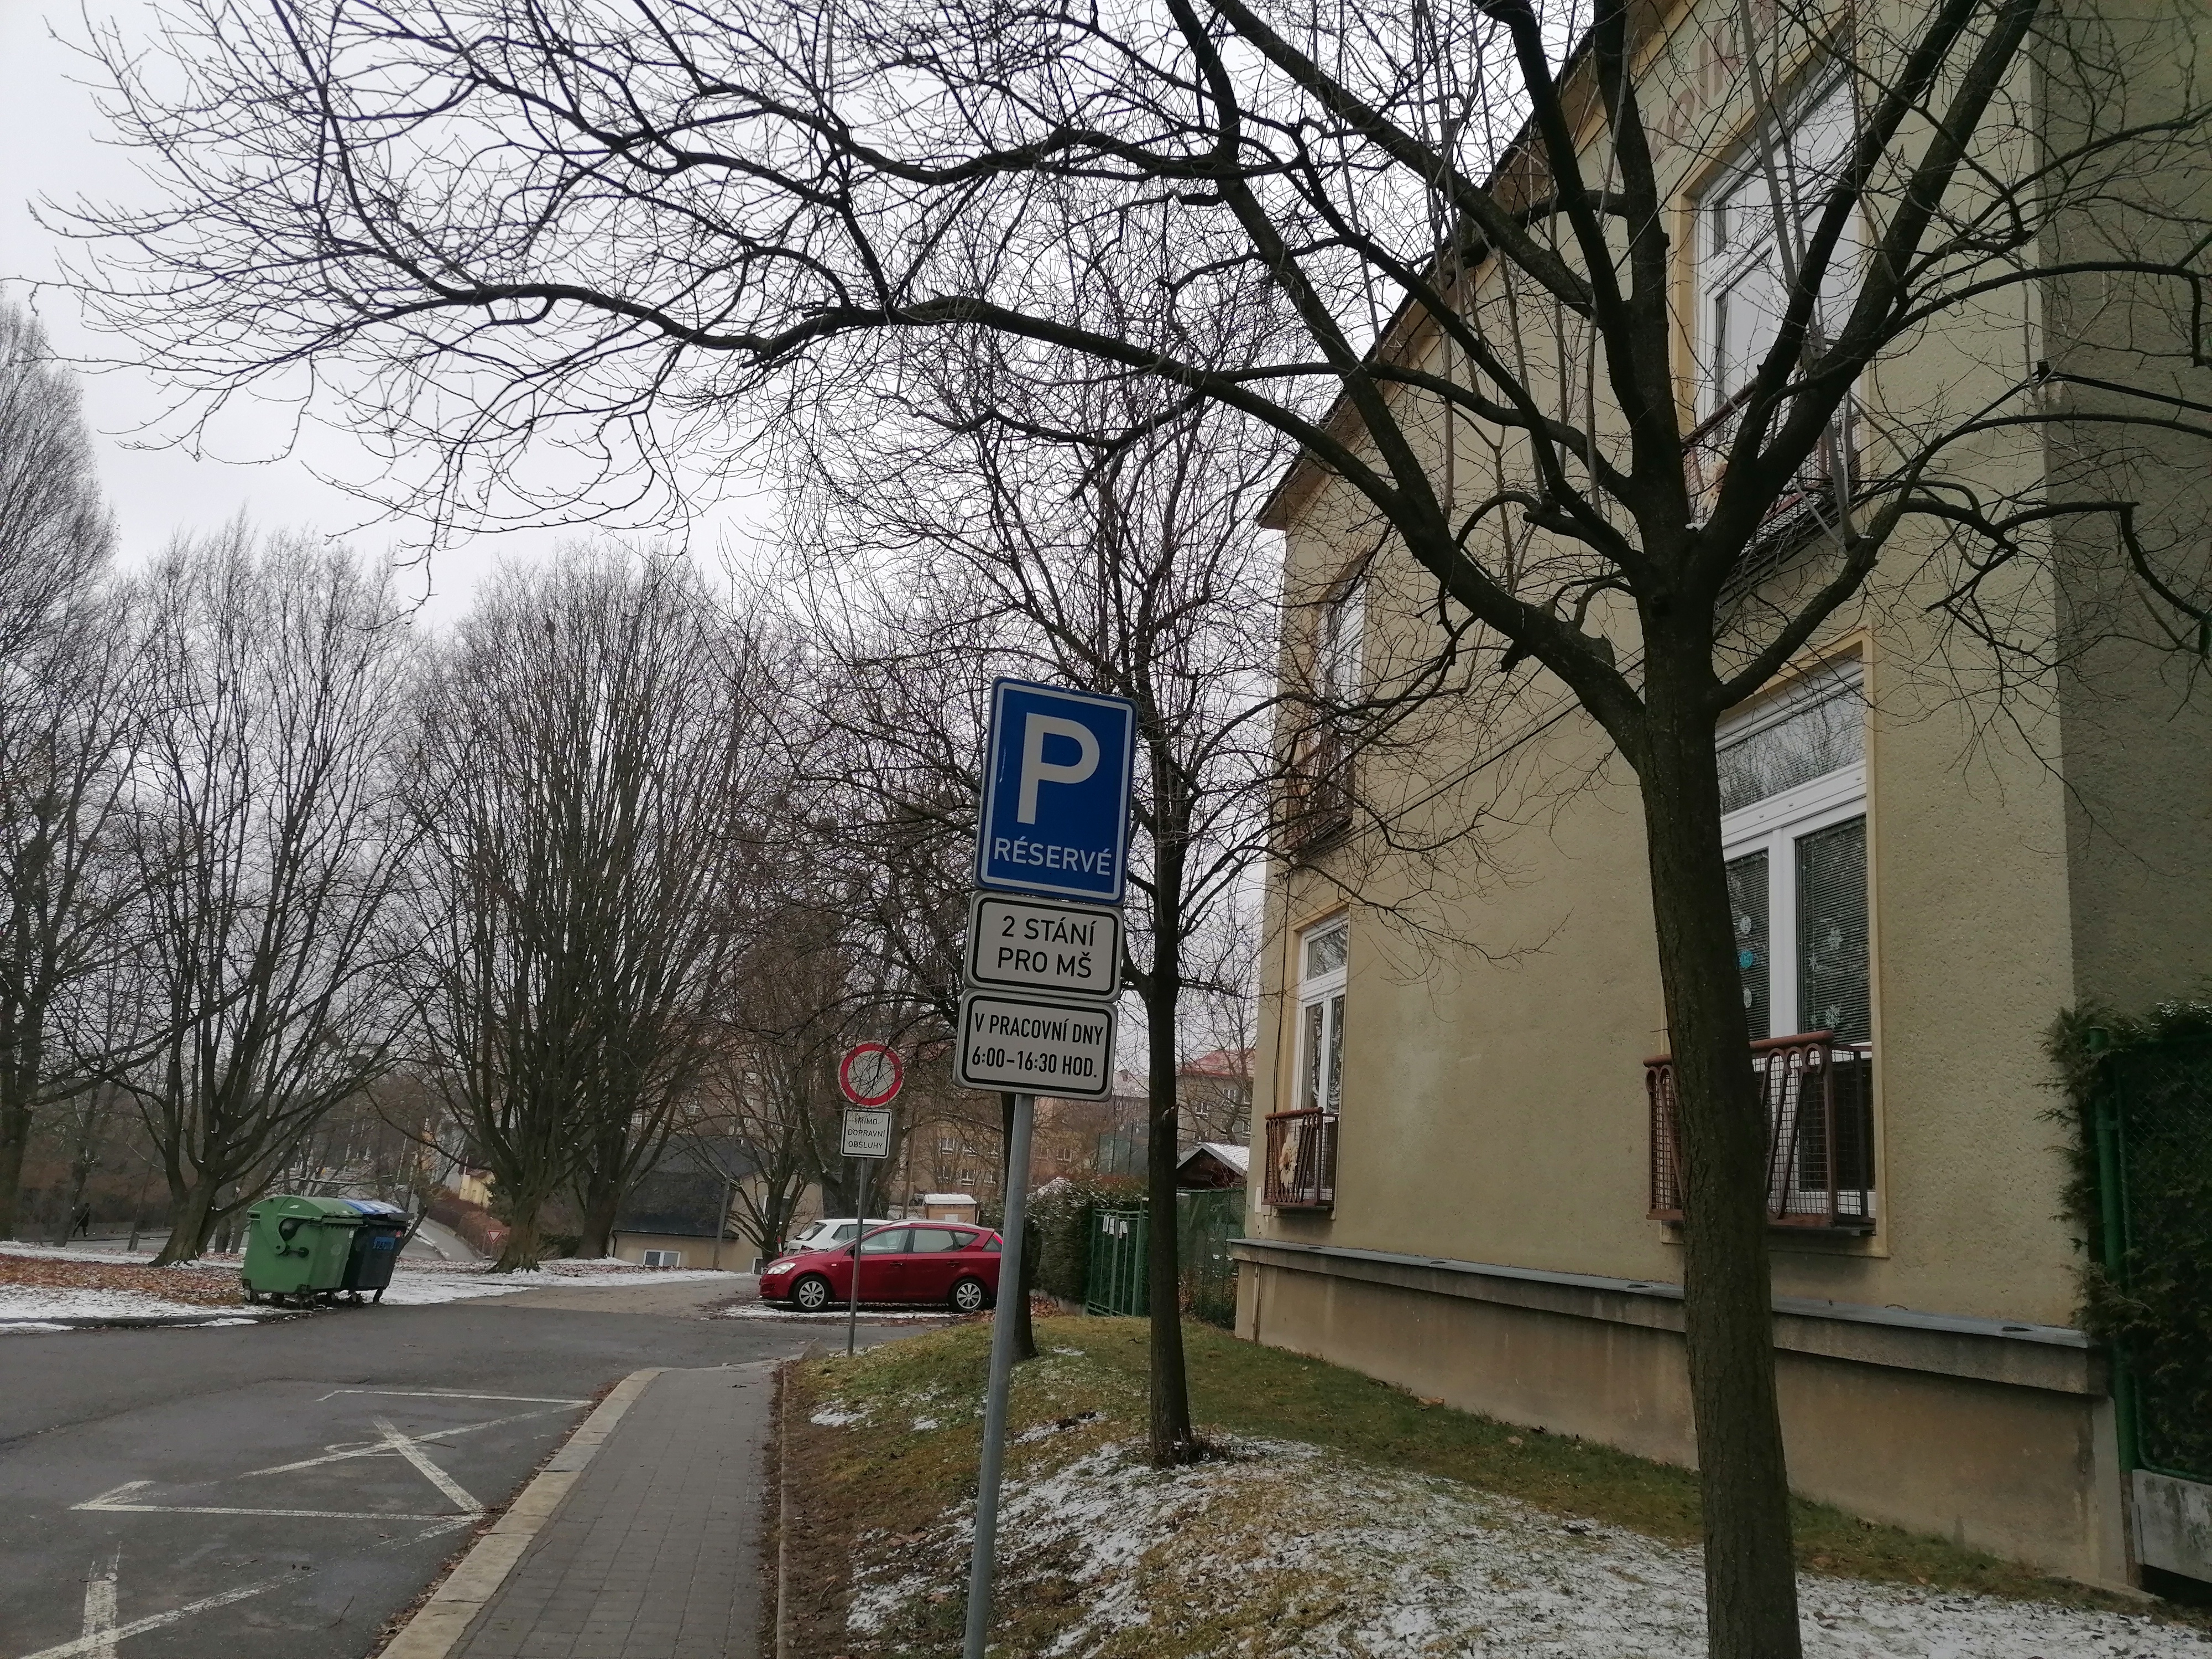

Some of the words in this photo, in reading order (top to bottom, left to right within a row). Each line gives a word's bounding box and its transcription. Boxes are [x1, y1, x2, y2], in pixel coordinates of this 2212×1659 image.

[1017, 712, 1100, 825] P
[994, 836, 1112, 875] RÉSERVÉ
[1001, 915, 1015, 937] 2
[1024, 916, 1097, 947] STÁNÍ
[998, 947, 1048, 973] PRO
[1056, 951, 1092, 978] MŠ
[975, 1013, 985, 1032] V
[989, 1014, 1070, 1042] PRACOVNÍ
[1072, 1024, 1104, 1045] DNY
[1062, 1055, 1097, 1078] HOD.
[848, 1129, 885, 1137] DOPRAVNÍ
[848, 1141, 883, 1149] OBSLUHY
